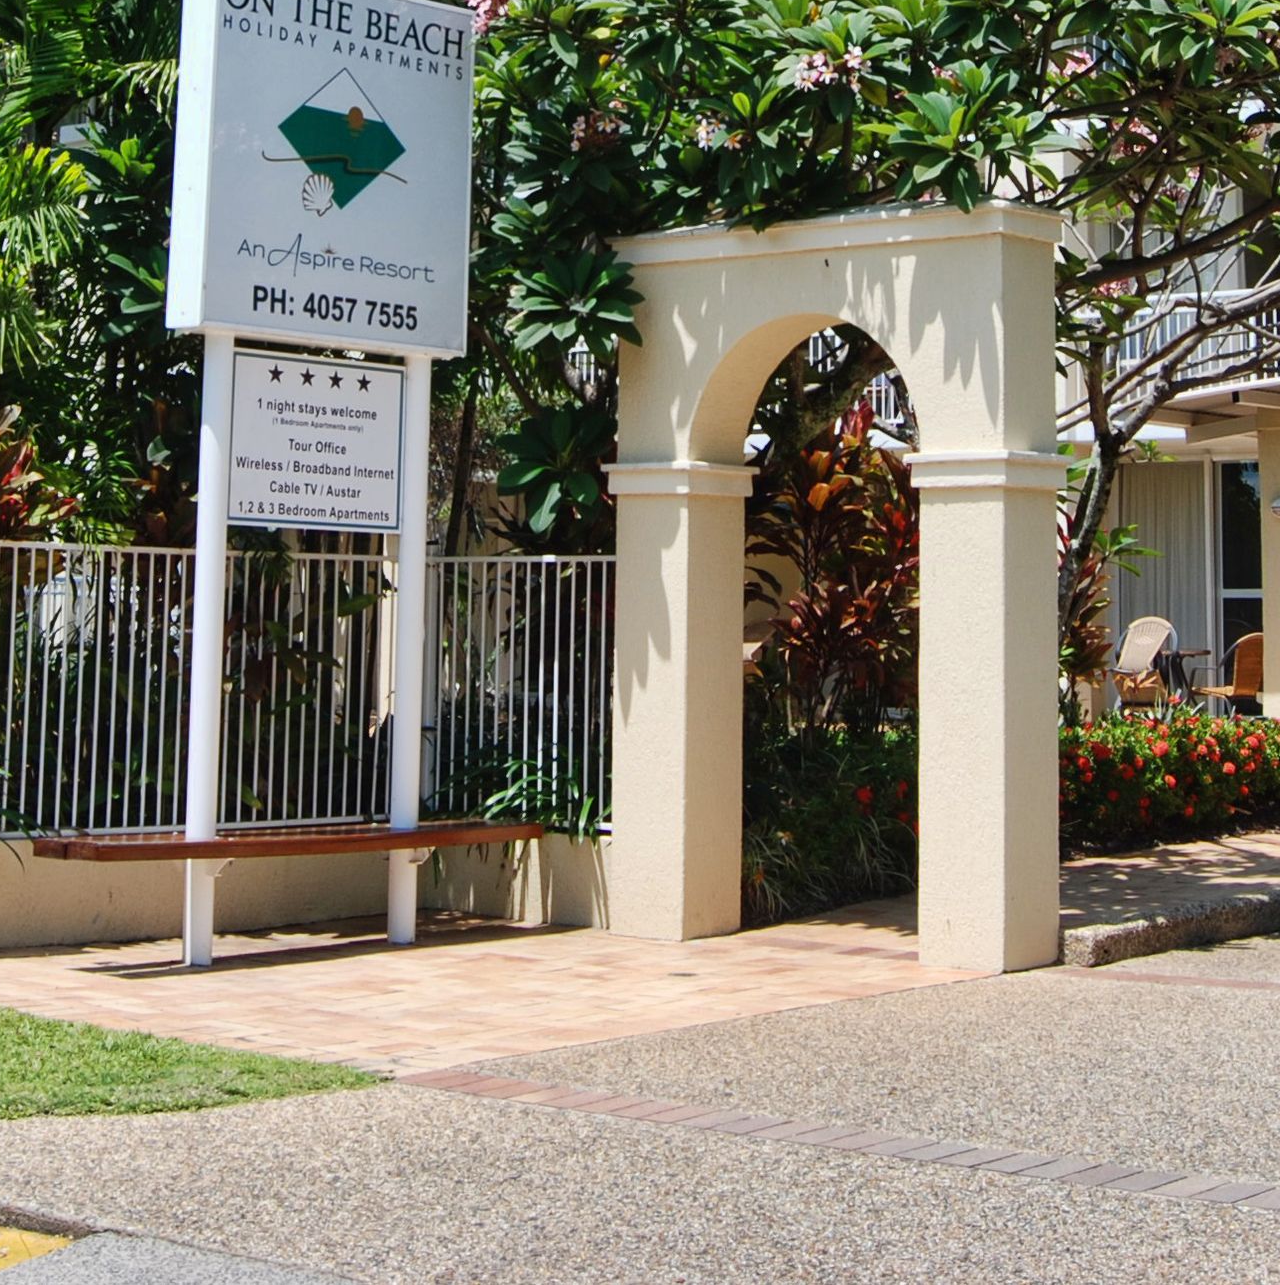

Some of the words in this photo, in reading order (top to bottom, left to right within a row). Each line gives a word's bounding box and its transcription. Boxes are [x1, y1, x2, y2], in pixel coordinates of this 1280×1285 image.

[365, 8, 465, 60] BEACH
[224, 14, 318, 48] HOLIDAY
[333, 40, 464, 81] APARTMENTS
[236, 238, 265, 259] An
[267, 233, 355, 277] Aspire
[359, 256, 435, 283] Resort
[252, 285, 295, 316] PH:
[303, 292, 357, 323] 4057
[365, 300, 418, 331] 7555
[257, 398, 263, 409] 1
[266, 400, 295, 414] night
[298, 403, 327, 418] stays
[331, 406, 377, 420] welcome
[280, 418, 309, 427] Bedroom
[310, 420, 347, 432] Apartments
[288, 438, 312, 453] Tour
[315, 440, 347, 455] Office
[236, 456, 283, 472] Wireless
[293, 460, 351, 477] Broadband
[354, 466, 394, 480] Internet
[269, 481, 301, 495] Cable
[304, 483, 318, 495] TV
[326, 485, 361, 498] Austar
[238, 501, 254, 515] 1,2
[257, 502, 265, 514] &
[268, 502, 275, 514] 3
[278, 503, 327, 518] Bedroom
[329, 506, 390, 522] Apartments
